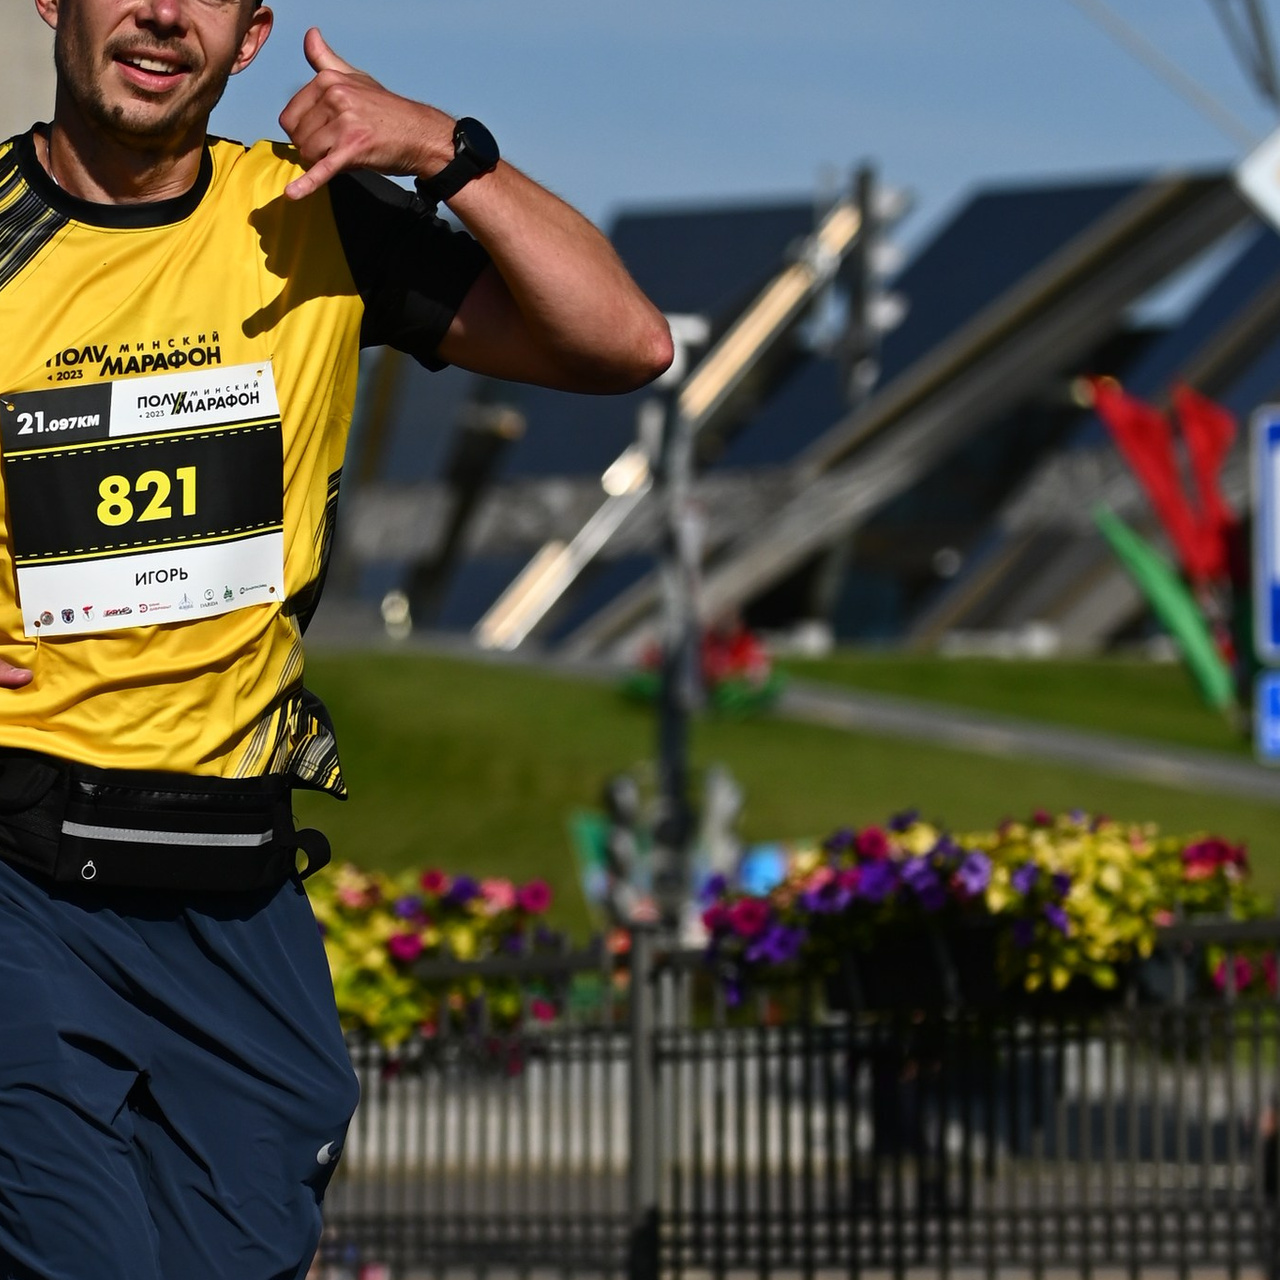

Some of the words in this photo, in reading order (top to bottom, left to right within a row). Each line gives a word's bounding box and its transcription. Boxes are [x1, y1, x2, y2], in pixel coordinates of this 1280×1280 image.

[118, 331, 220, 353] МИНСКИЙ
[99, 346, 222, 377] МАРАФОН
[56, 369, 84, 381] 2023
[189, 381, 259, 397] МИНСКИЙ
[137, 391, 182, 415] ПОЛУ
[145, 410, 165, 418] 2023
[175, 391, 260, 415] МАРАФОН
[96, 466, 197, 526] 821
[135, 567, 189, 586] ИГОРЬ
